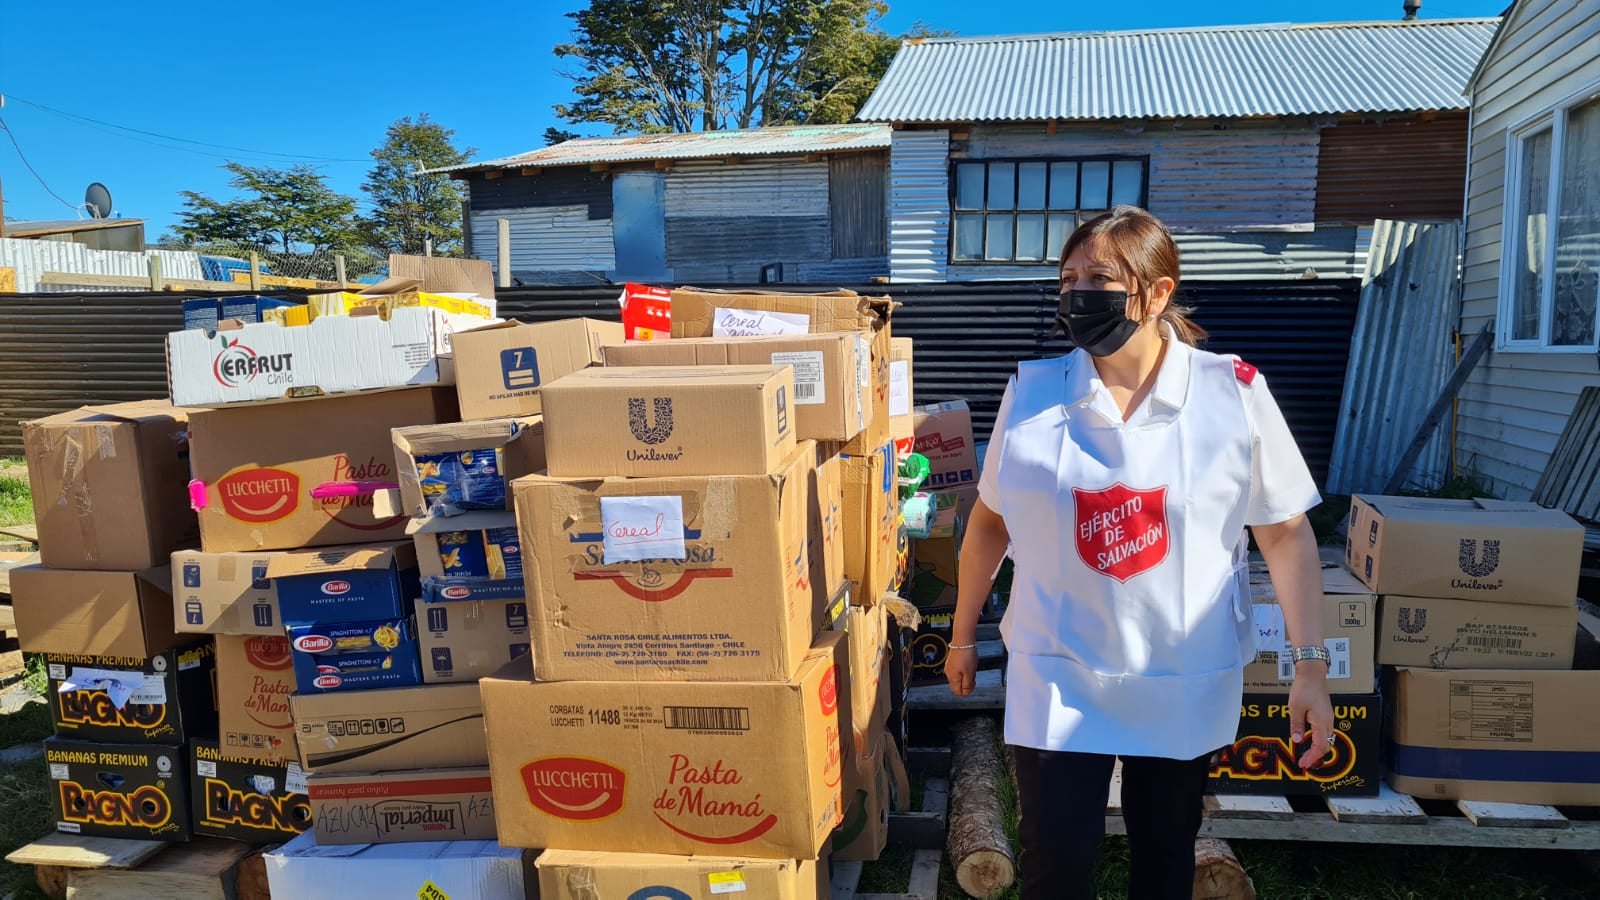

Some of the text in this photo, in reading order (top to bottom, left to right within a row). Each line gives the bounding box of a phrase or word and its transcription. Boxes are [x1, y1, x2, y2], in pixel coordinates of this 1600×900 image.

[721, 314, 765, 330] Cereal
[224, 353, 292, 377] ERFRUT
[514, 351, 523, 369] 7
[267, 372, 294, 385] Chile
[627, 449, 683, 461] Unilever
[333, 454, 391, 482] Pasta
[226, 478, 290, 497] LUCCHETTI
[608, 512, 664, 538] Cereal
[1080, 495, 1142, 542] EJÉRCITO
[1105, 525, 1125, 547] DE
[1097, 522, 1163, 570] SALVACIÓN
[327, 583, 349, 591] Barilla
[1451, 579, 1502, 591] Unilever
[302, 638, 329, 648] Barilla
[1393, 634, 1428, 644] Unilever
[47, 652, 144, 666] BANANAS PREMIUM
[253, 675, 291, 694] Pasta
[244, 694, 290, 713] de Mam
[549, 705, 584, 715] CORBATAS
[551, 717, 585, 728] LUCCHETTI
[588, 709, 621, 726] 11488
[47, 750, 148, 767] BANANAS PREMIUM
[1208, 728, 1357, 783] AGNO
[532, 769, 615, 789] LUCCHETTI
[668, 754, 743, 785] Pasta
[1319, 775, 1367, 792] Superior
[60, 780, 171, 828] BAGNO
[653, 786, 765, 818] de Mamá
[383, 805, 456, 833] Imperial
